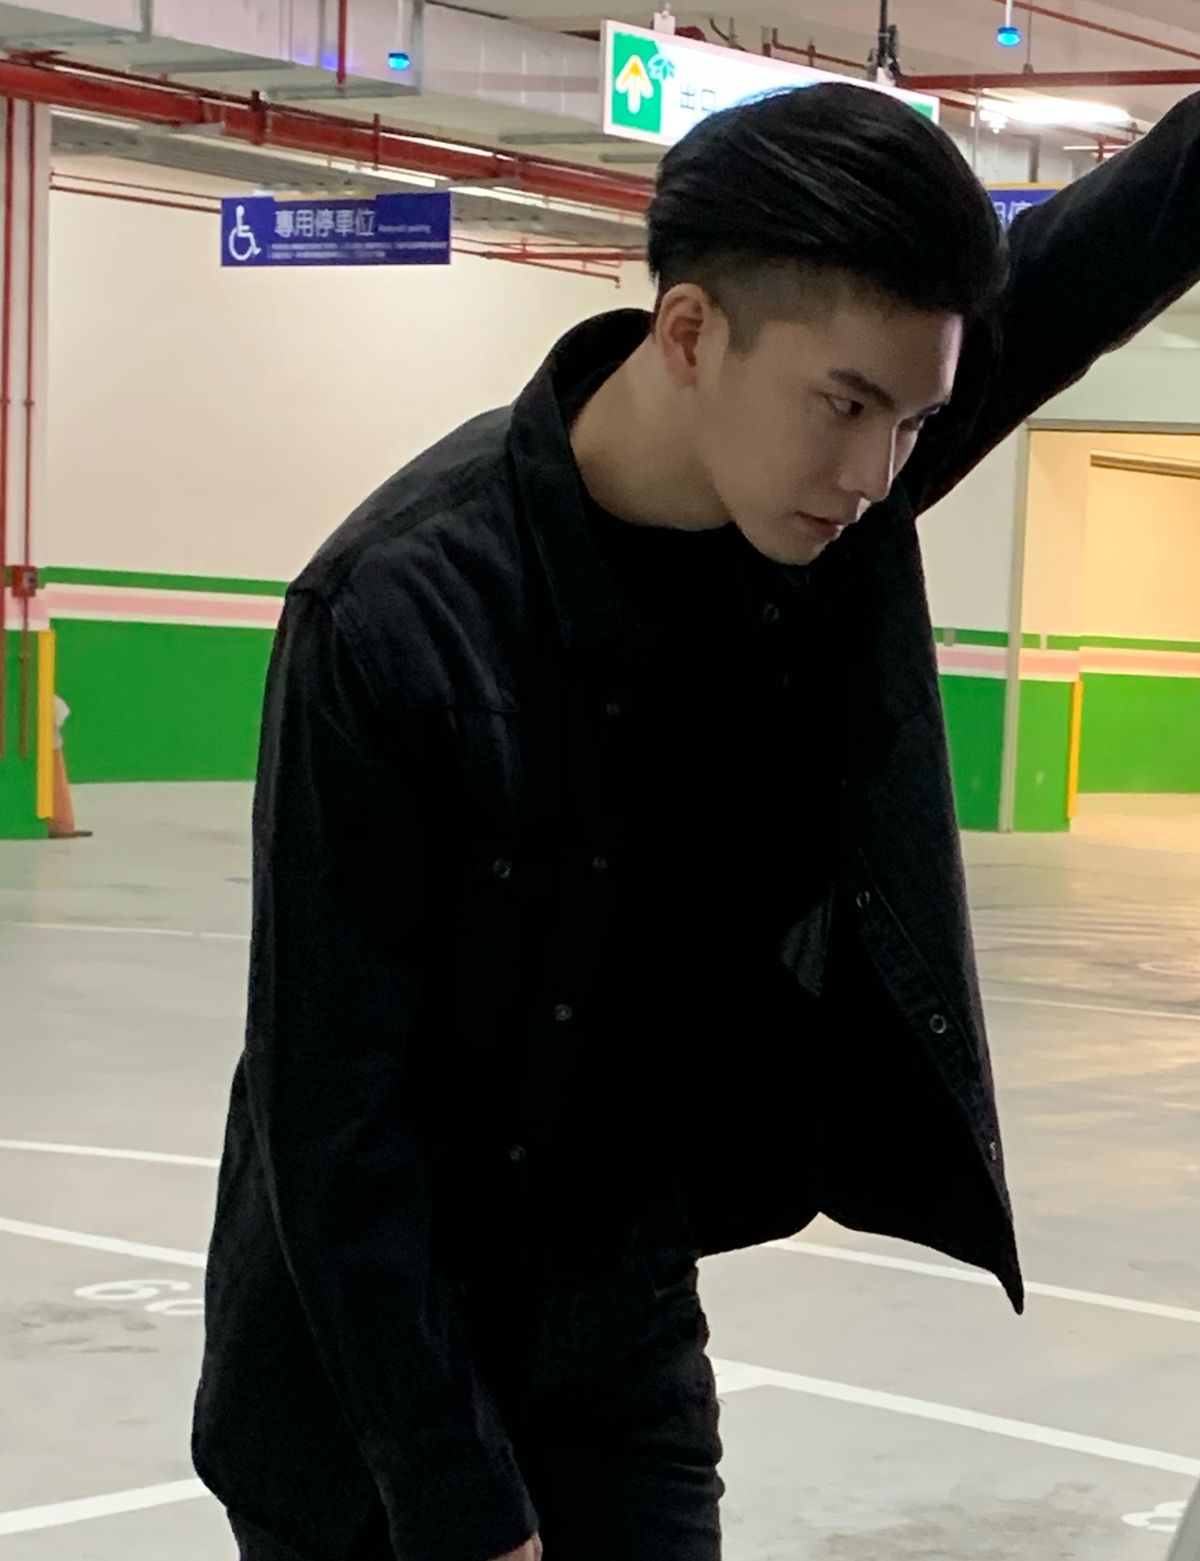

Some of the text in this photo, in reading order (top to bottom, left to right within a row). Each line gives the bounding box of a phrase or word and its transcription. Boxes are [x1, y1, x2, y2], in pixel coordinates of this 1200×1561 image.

[680, 83, 716, 112] 出口
[274, 208, 375, 238] 專用停車位
